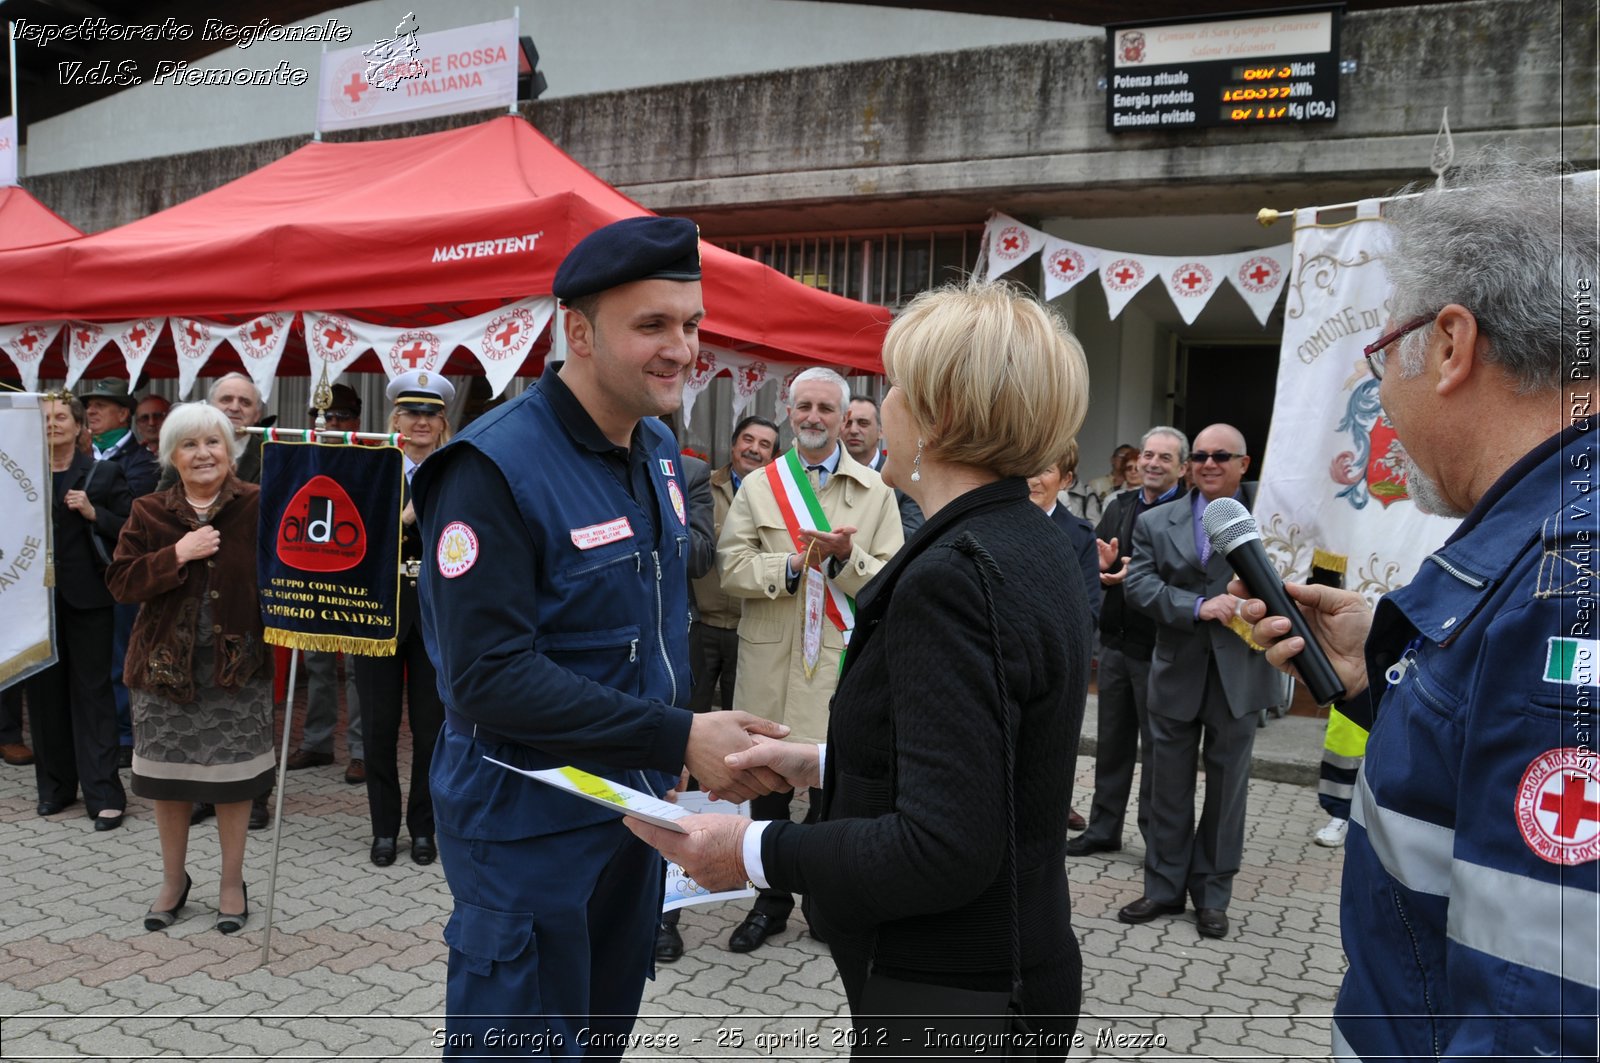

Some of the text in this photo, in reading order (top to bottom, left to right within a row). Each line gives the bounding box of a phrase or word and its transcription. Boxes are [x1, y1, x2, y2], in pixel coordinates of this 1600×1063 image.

[452, 46, 507, 66] ROSSA
[1290, 61, 1316, 77] Watt
[406, 71, 483, 96] ITALIANA
[1113, 70, 1189, 89] Potenza attuale
[1289, 81, 1313, 97] kWh
[1113, 90, 1194, 110] Energia prodotta
[1113, 109, 1196, 127] Emissioni evitate
[1288, 102, 1304, 120] Kg
[431, 233, 540, 263] MASTERTENT
[1297, 306, 1382, 365] COMUNE DI
[283, 499, 359, 547] aido
[271, 577, 368, 596] GRUPPO COMUNALE
[266, 603, 315, 619] GIORGIO
[320, 609, 392, 627] CANAVESE
[1522, 766, 1549, 801] CROCE
[1520, 805, 1552, 856] VOLONTARI
